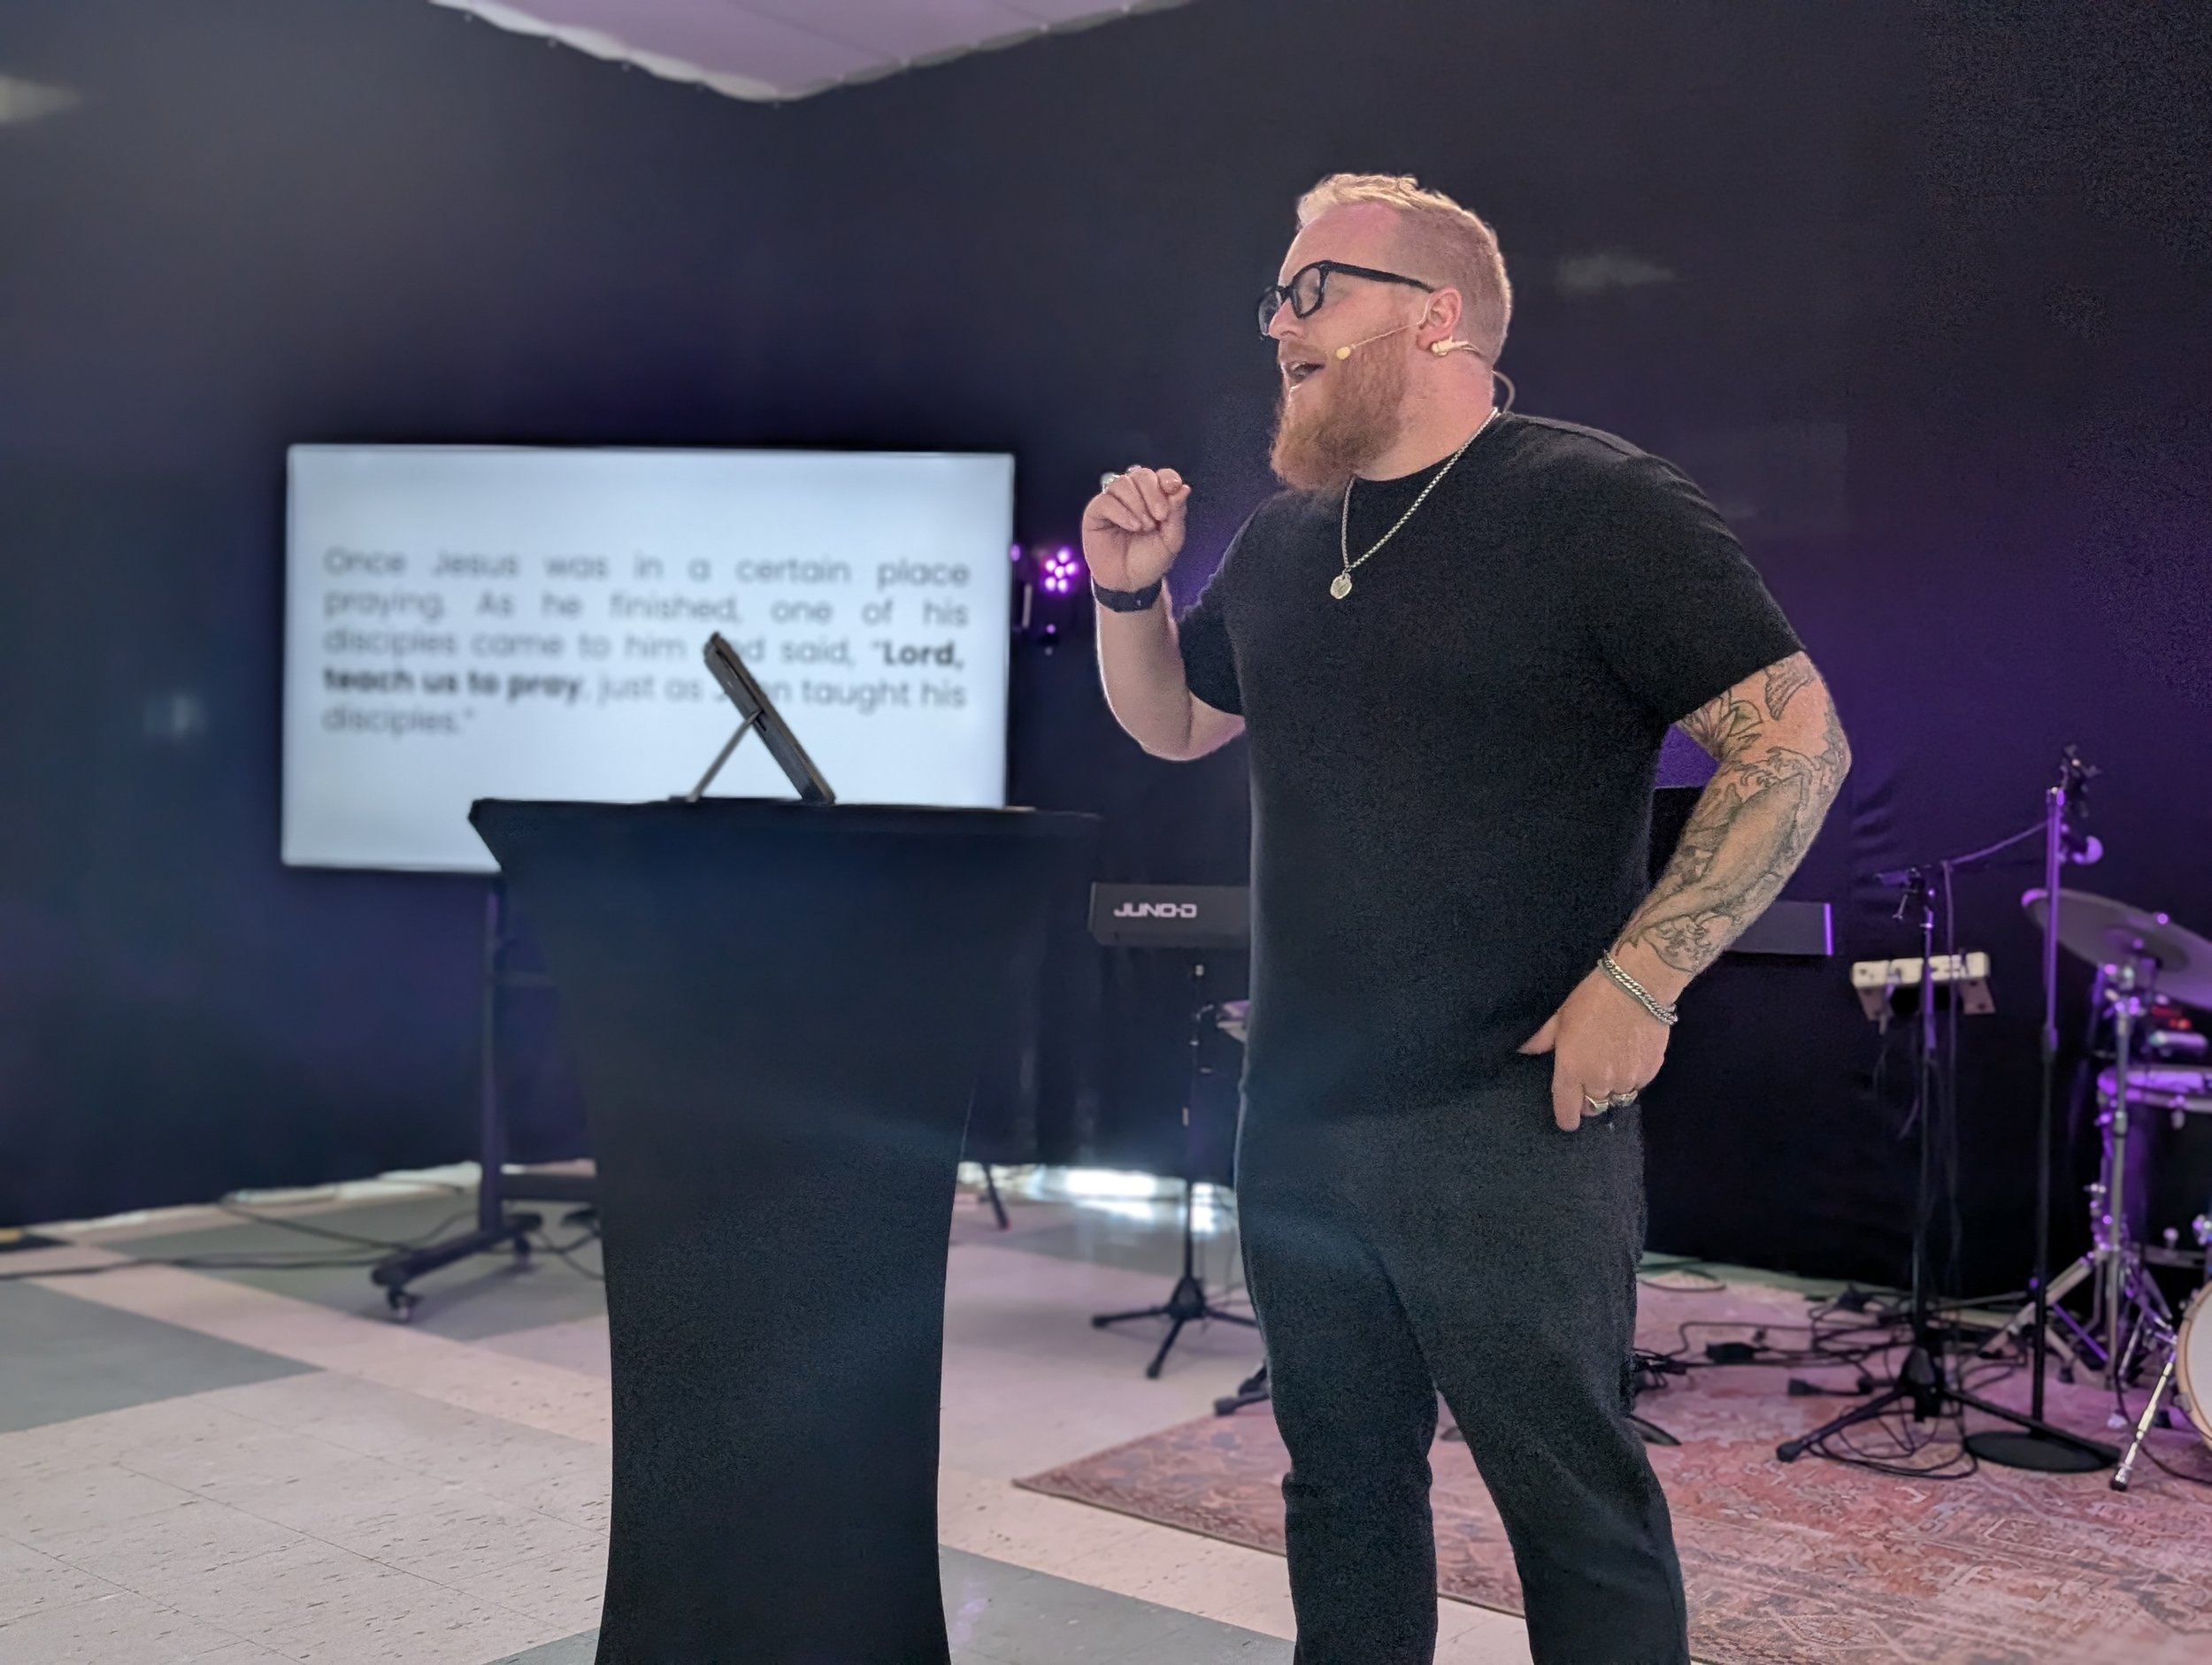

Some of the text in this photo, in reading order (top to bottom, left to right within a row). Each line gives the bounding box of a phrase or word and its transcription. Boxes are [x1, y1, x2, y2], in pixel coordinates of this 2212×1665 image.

[325, 547, 970, 591] Once Jesus was in a certain place
[478, 591, 513, 614] As
[542, 591, 582, 616] he
[611, 591, 741, 623] finished,
[771, 600, 833, 624] one
[862, 597, 893, 625] of
[924, 596, 968, 626] his
[323, 625, 456, 657] disciples
[472, 633, 564, 656] came
[579, 634, 610, 657] to
[625, 632, 686, 659] him
[781, 637, 856, 670] said,
[323, 667, 415, 693] teach
[422, 673, 458, 693] us
[467, 671, 500, 695] to
[597, 671, 655, 707] just
[665, 679, 702, 701] as
[802, 679, 910, 715] taught
[921, 679, 965, 708] his
[1114, 902, 1197, 917] JUNO-D
